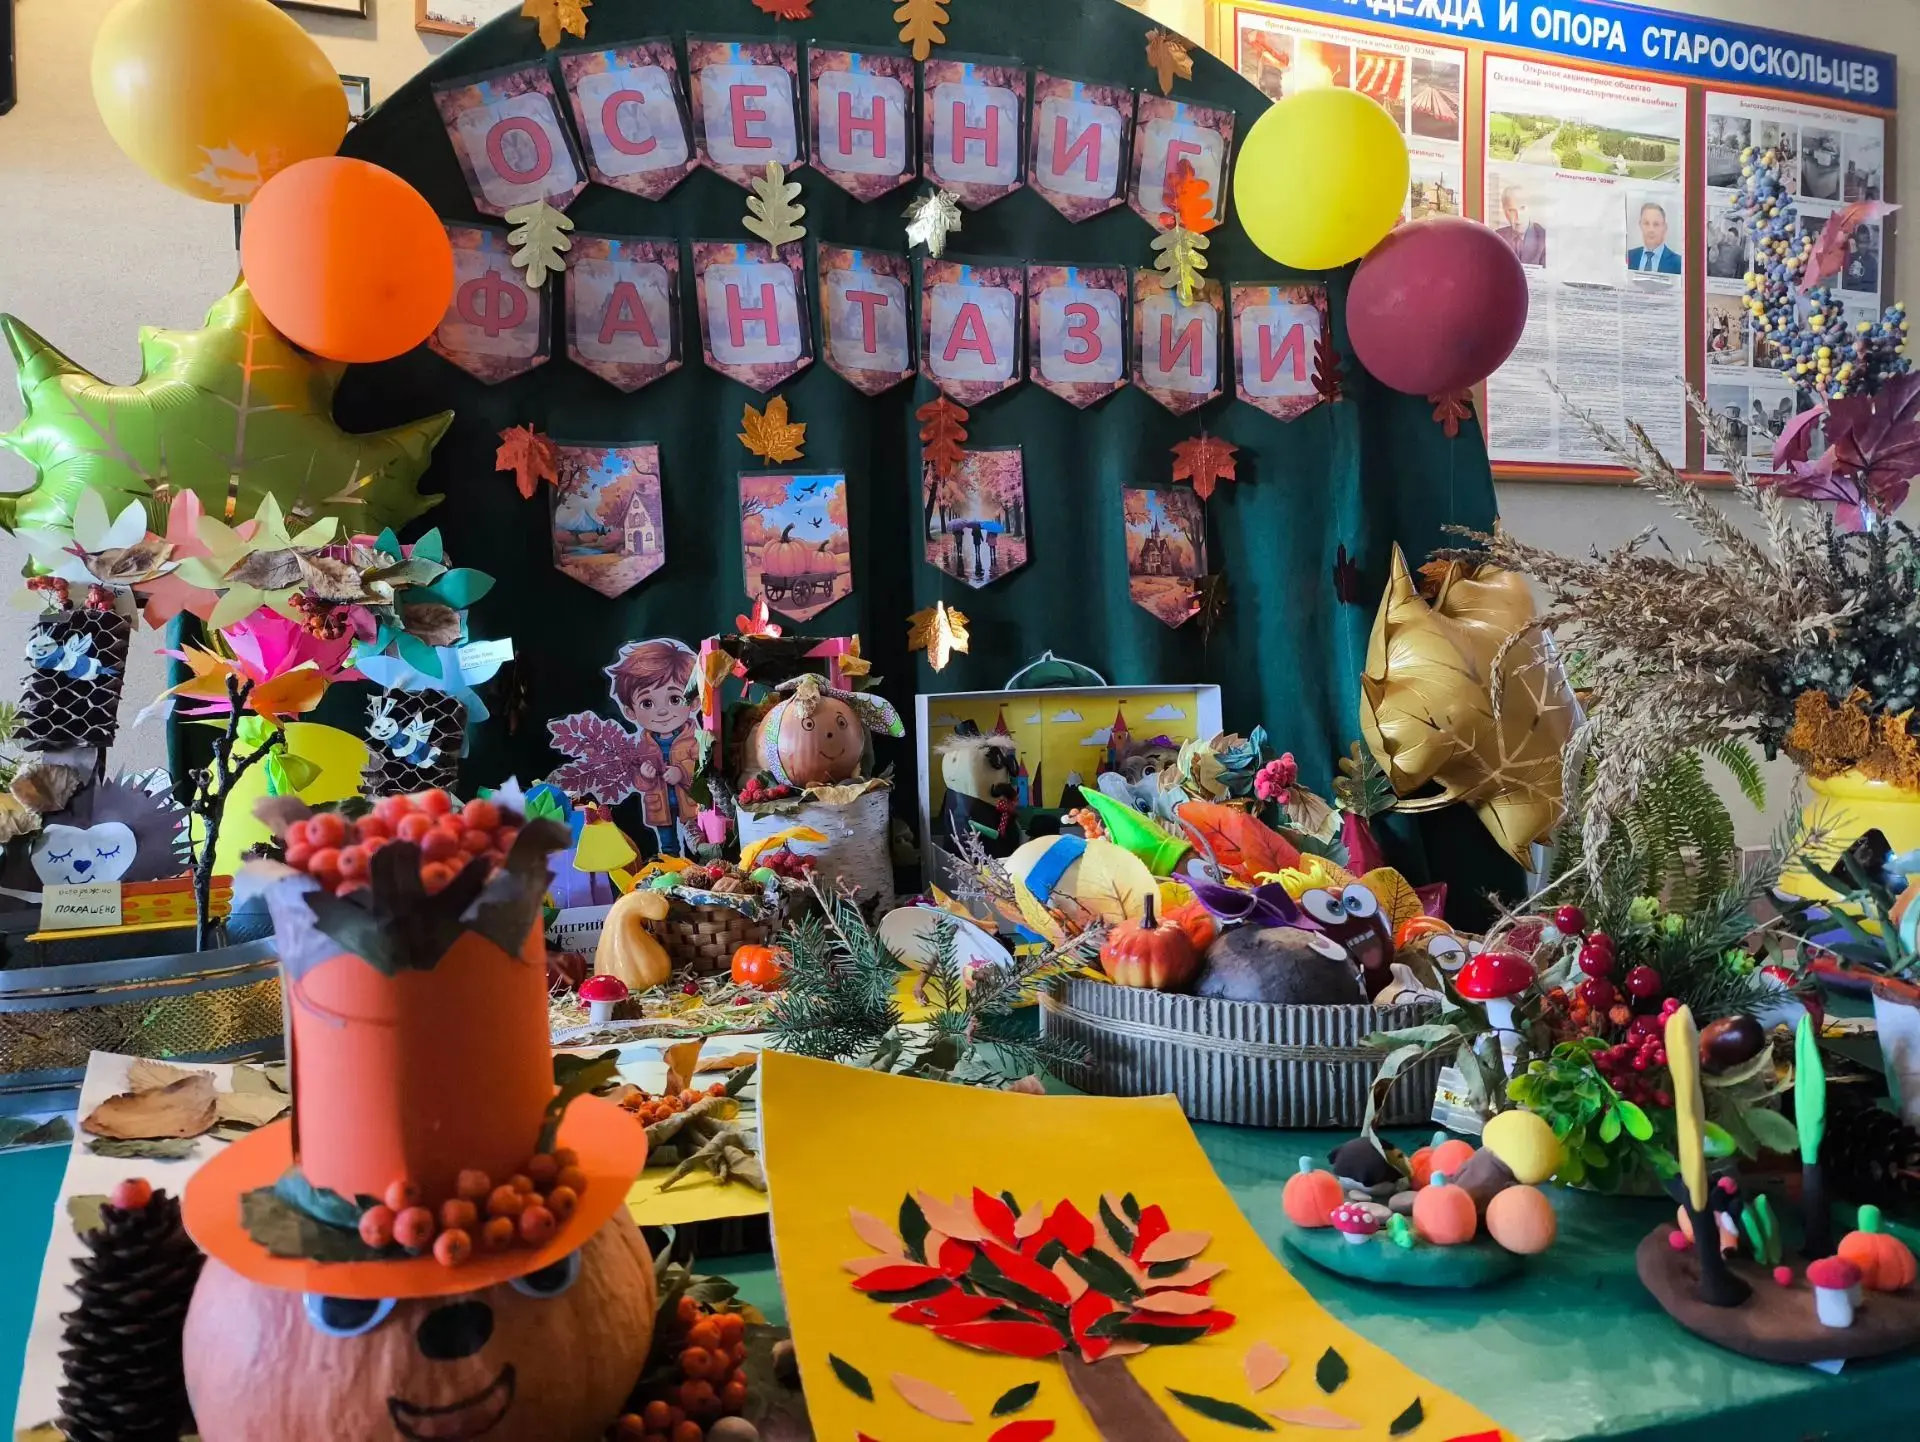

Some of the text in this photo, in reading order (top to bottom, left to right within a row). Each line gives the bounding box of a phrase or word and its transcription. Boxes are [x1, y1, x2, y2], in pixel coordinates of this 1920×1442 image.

[1330, 0, 1880, 95] ДЕЖДА И ОПОРА СТАРООСКОЛЬЦЕВ
[1493, 71, 1542, 87] Оскольский
[1641, 97, 1678, 108] комбинат
[1522, 63, 1652, 93] Открытое акционерное общество
[54, 904, 116, 914] ПОКРАШЕНО
[549, 918, 604, 934] МИТРИЙ
